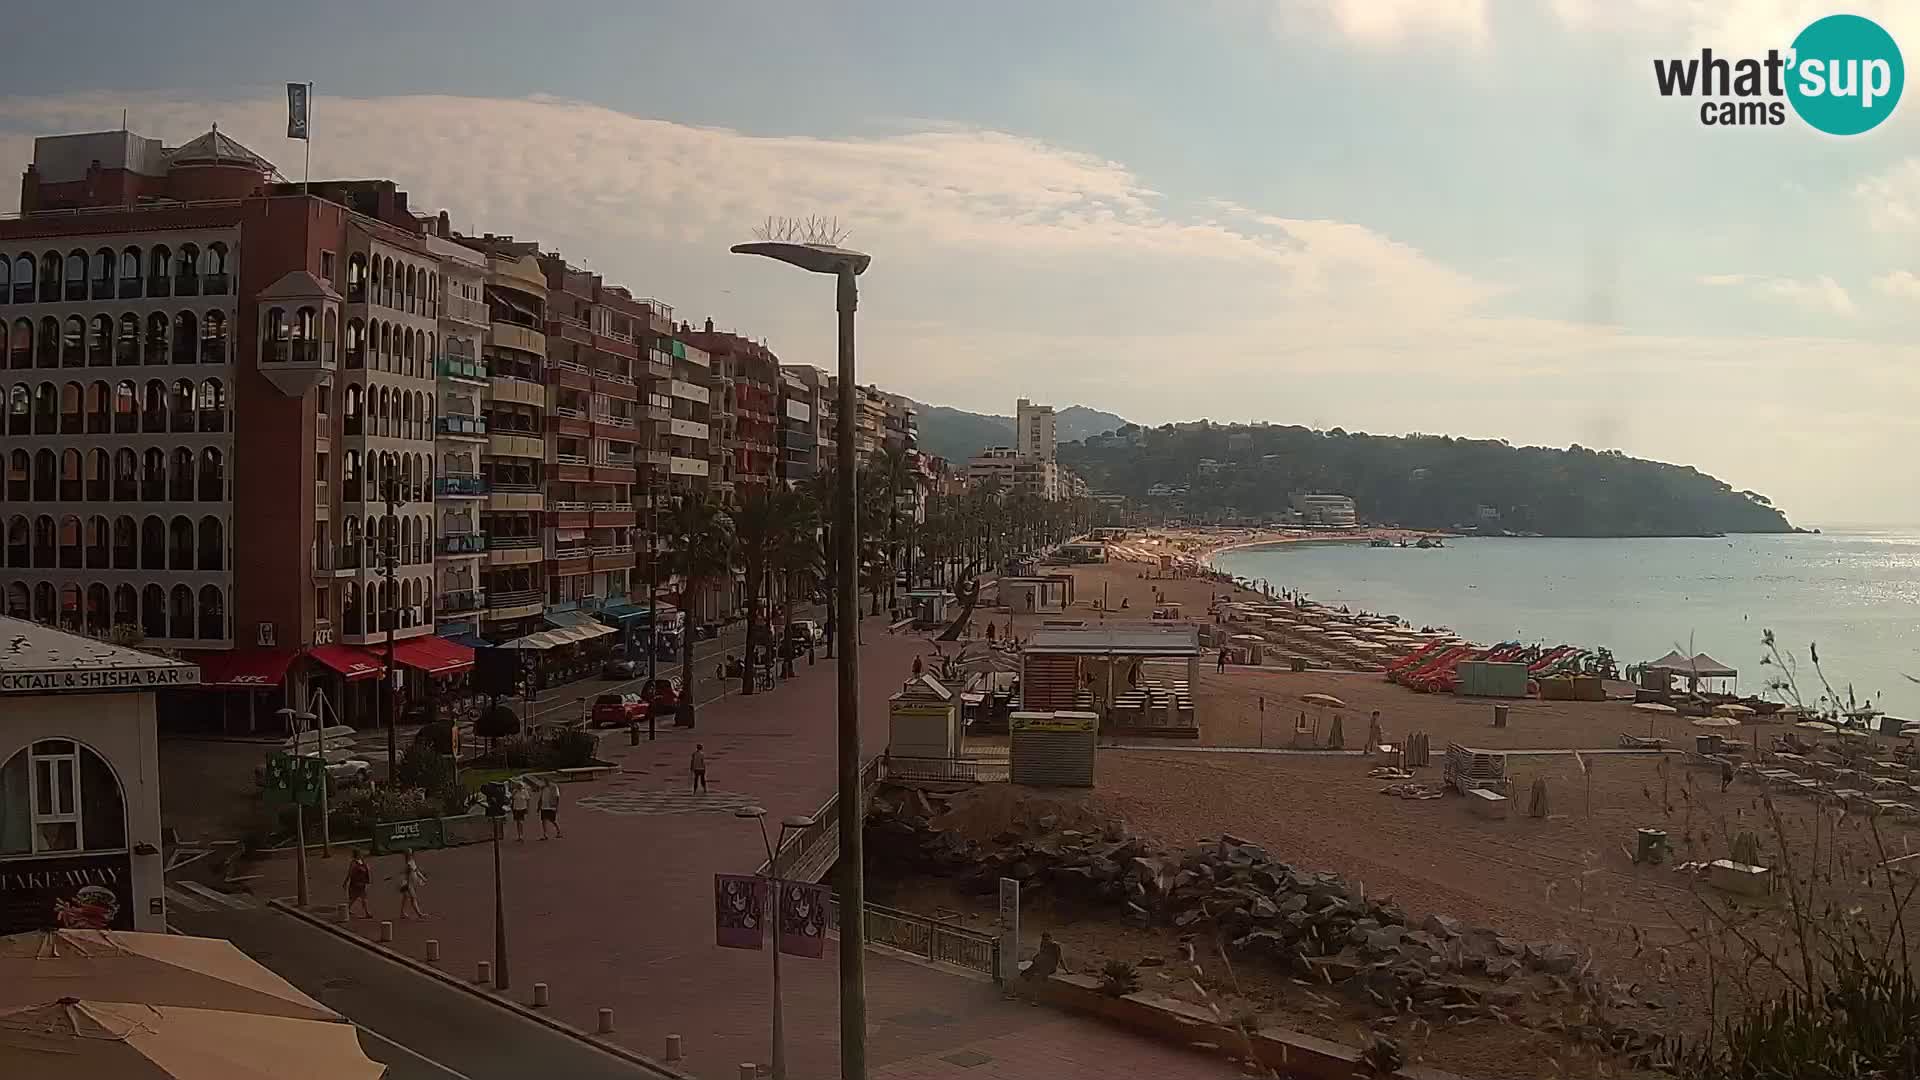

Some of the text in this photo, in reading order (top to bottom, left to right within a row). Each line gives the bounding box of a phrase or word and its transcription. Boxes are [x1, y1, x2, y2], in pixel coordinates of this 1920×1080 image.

[315, 628, 334, 645] KFC
[2, 669, 178, 689] CKTAIL & SHISHA BAR
